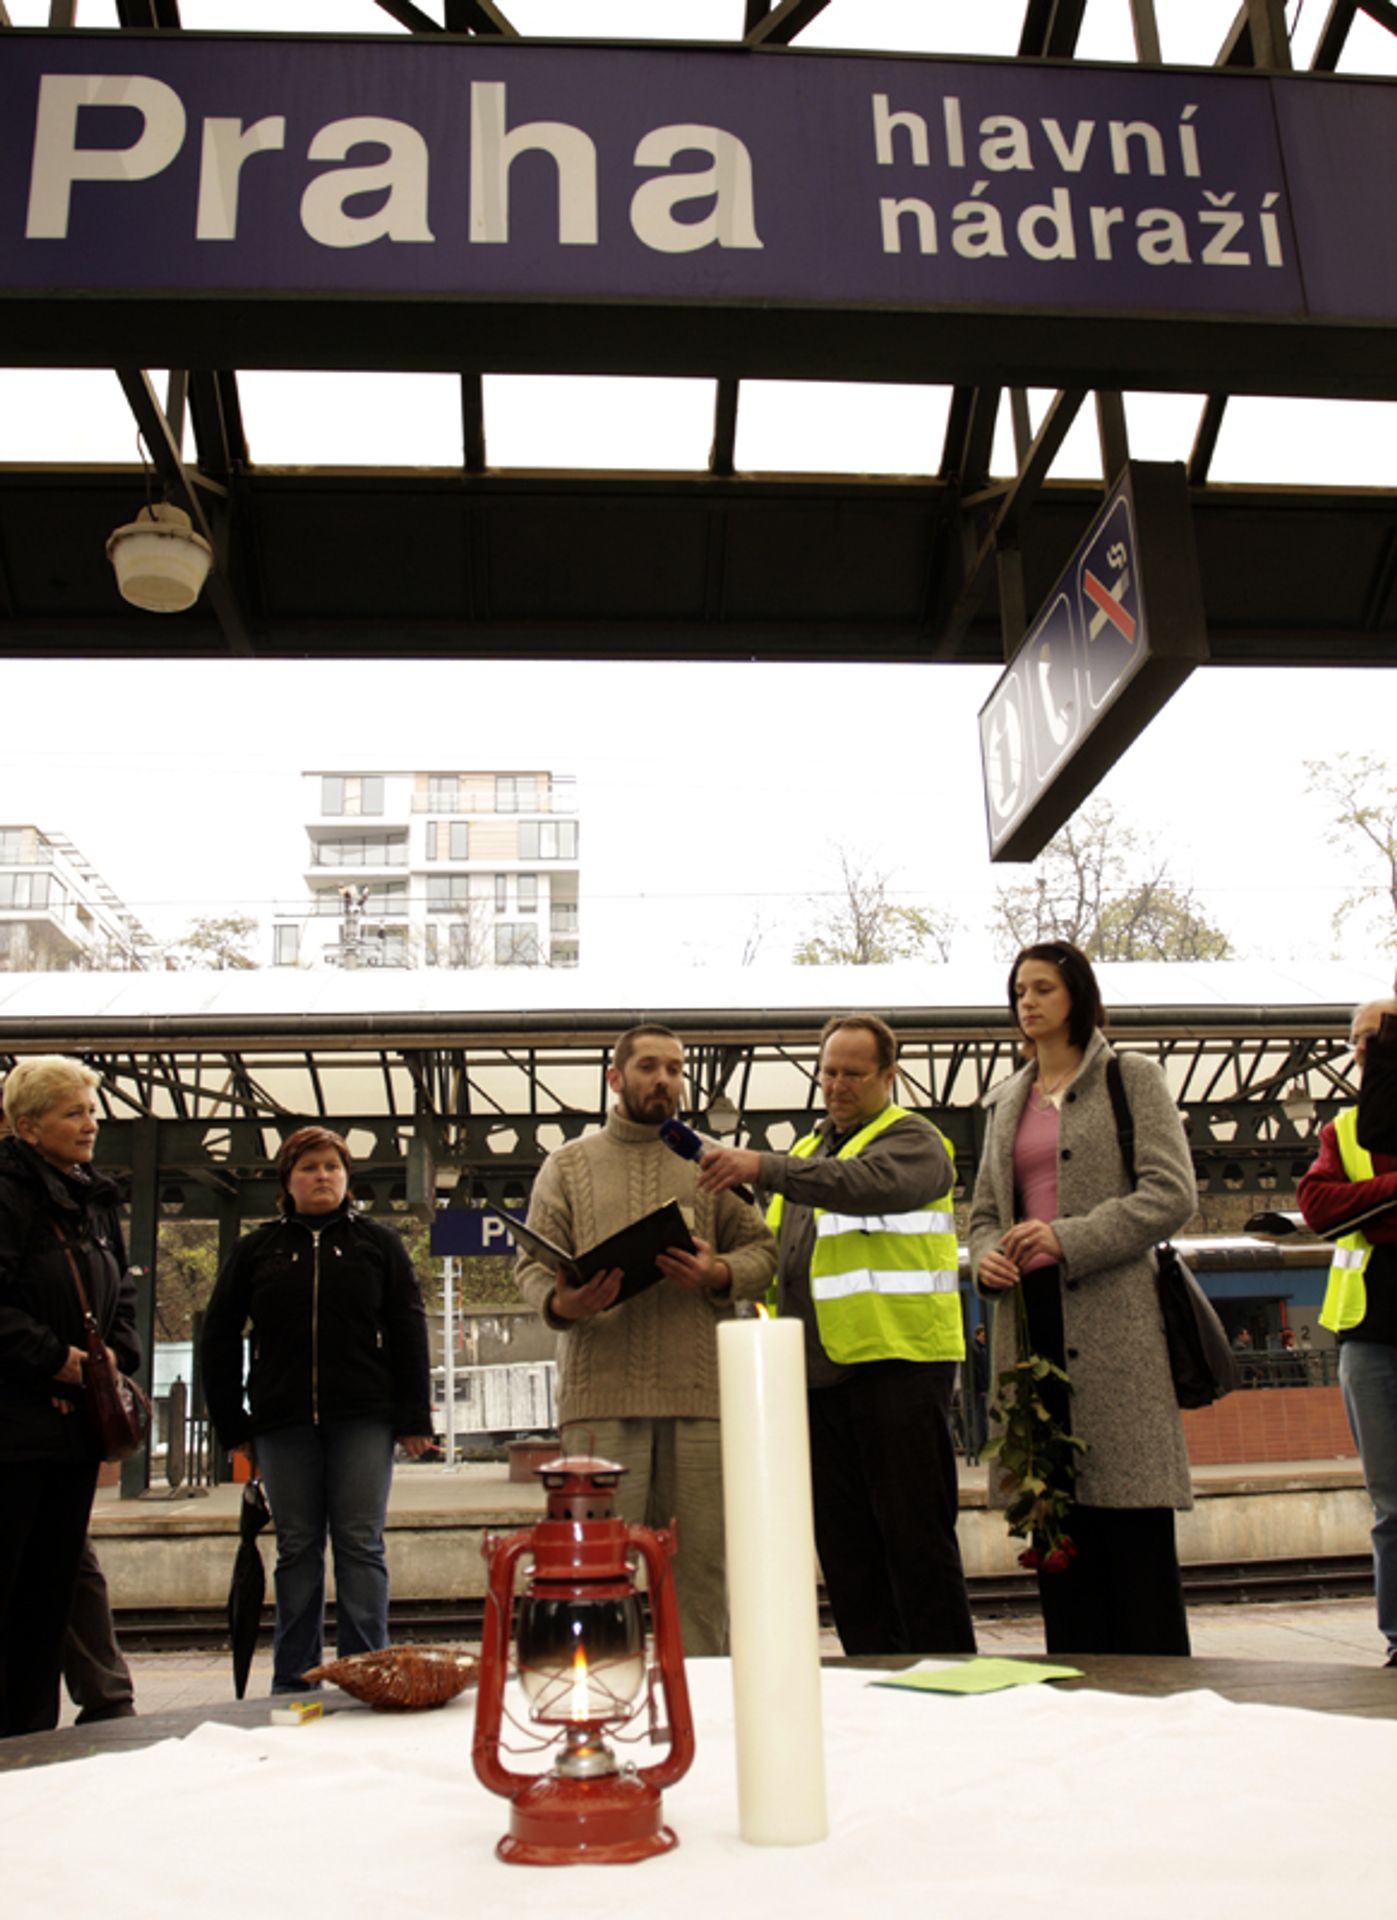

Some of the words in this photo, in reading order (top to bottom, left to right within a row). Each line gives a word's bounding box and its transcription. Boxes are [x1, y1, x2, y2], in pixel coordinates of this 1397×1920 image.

[25, 73, 764, 254] Praha
[872, 93, 1201, 177] hlavní
[879, 180, 1283, 267] nádraží
